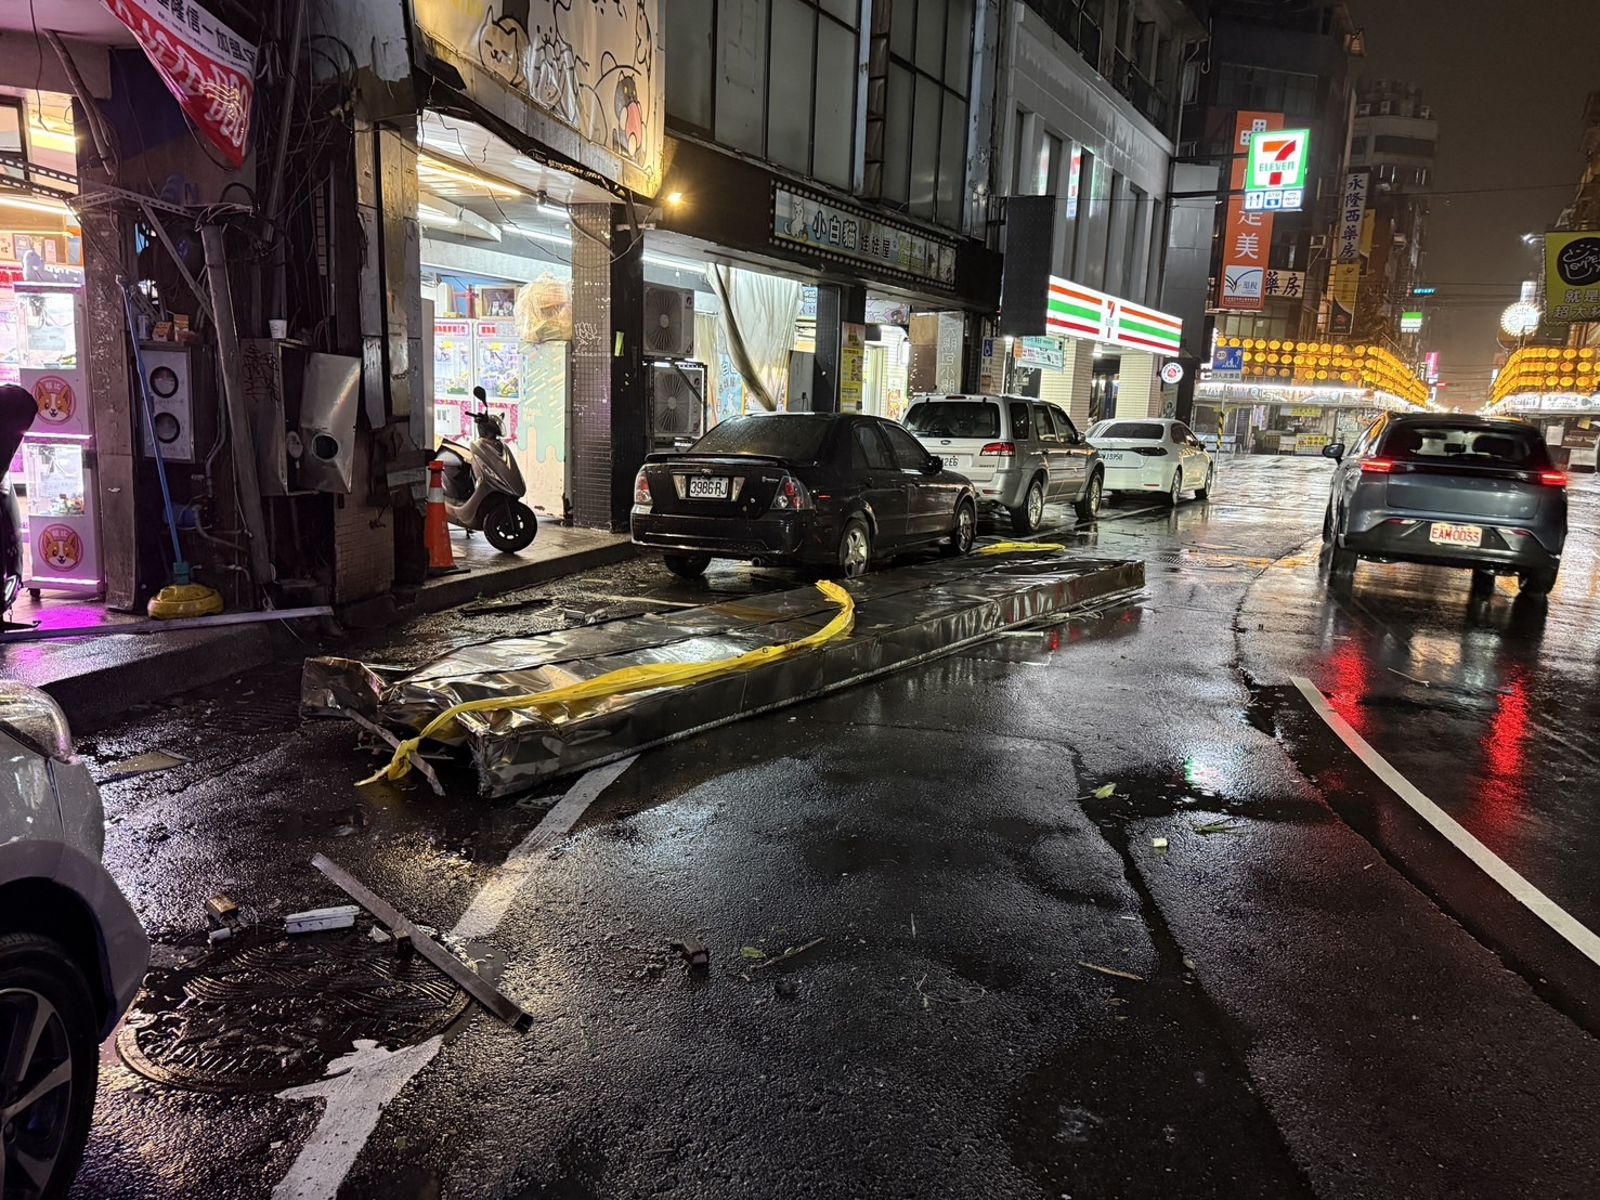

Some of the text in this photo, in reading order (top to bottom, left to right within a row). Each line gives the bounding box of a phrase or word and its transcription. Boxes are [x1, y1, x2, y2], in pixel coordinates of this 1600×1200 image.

[1262, 139, 1297, 185] 7
[811, 210, 858, 250] 小白貓
[1339, 174, 1365, 258] 永隆西藥房
[1265, 271, 1301, 298] 藥房
